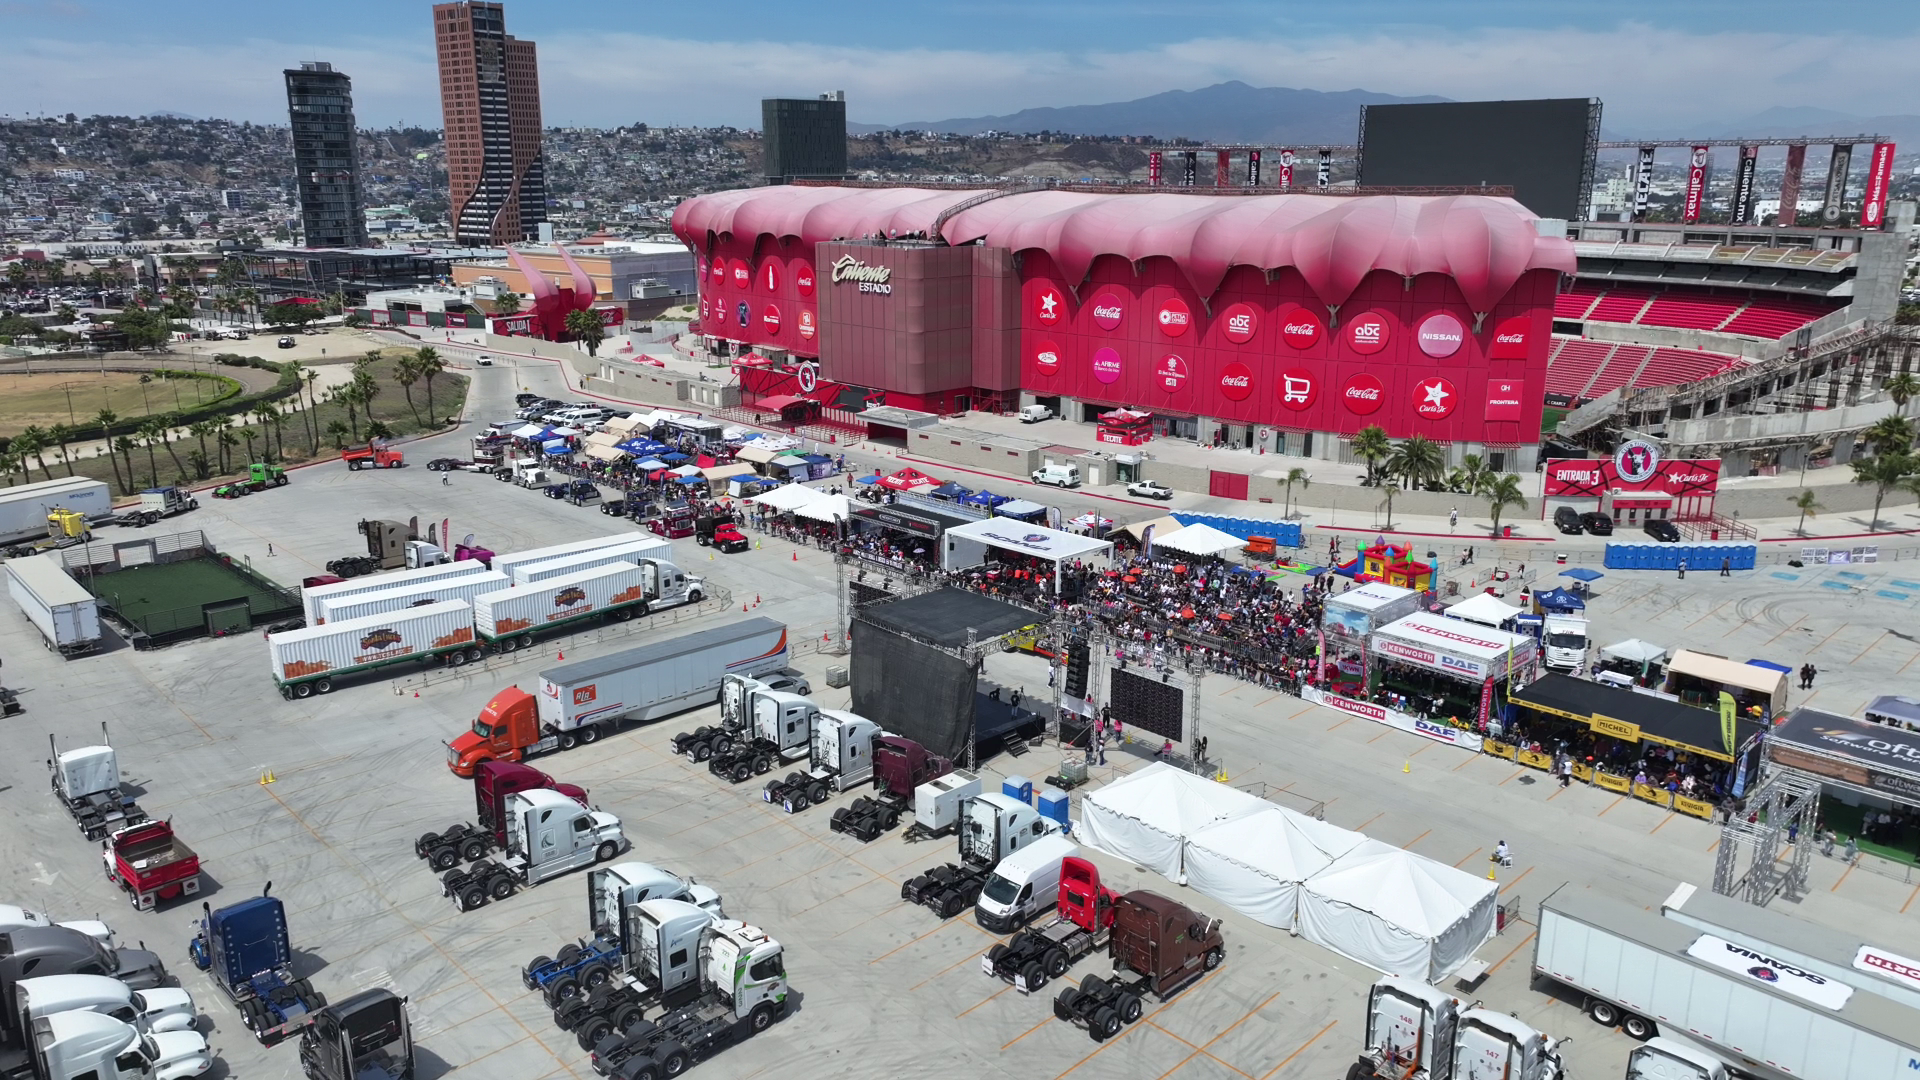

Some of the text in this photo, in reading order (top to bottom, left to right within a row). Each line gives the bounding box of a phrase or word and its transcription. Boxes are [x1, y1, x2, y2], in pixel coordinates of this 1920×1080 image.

[1875, 146, 1888, 180] Farmacia
[1633, 149, 1654, 216] TECATE
[1686, 168, 1703, 217] Calimax
[1736, 158, 1753, 222] caliente.mx
[832, 253, 891, 283] Caliente
[858, 282, 892, 294] ESTADIO
[1094, 305, 1122, 319] Coca-Cola
[506, 320, 527, 332] SALIDA
[1229, 314, 1250, 328] abc
[1284, 322, 1316, 336] Coca-Cola
[1355, 323, 1380, 336] abc
[1497, 332, 1525, 343] Coca-Cola
[1101, 360, 1120, 369] AFIRME
[1222, 375, 1249, 387] Coca-Cola
[1346, 386, 1380, 400] Coca-Cola
[1103, 434, 1123, 443] TECATE
[886, 476, 905, 485] TECATE
[909, 477, 930, 485] TECATE
[1556, 470, 1600, 485] ENTRADA 3
[1419, 626, 1501, 648] KENWORTH
[1388, 644, 1434, 662] KENWORTH
[1441, 655, 1479, 670] DAF
[1333, 699, 1385, 718] KENWORTH
[1479, 689, 1488, 728] KENWORTH
[1415, 720, 1455, 736] DAF
[1599, 721, 1629, 734] MICHEL
[1820, 735, 1889, 755] Software
[1726, 943, 1827, 985] SCANIA
[1400, 1015, 1413, 1025] 148
[1485, 1049, 1499, 1059] 147
